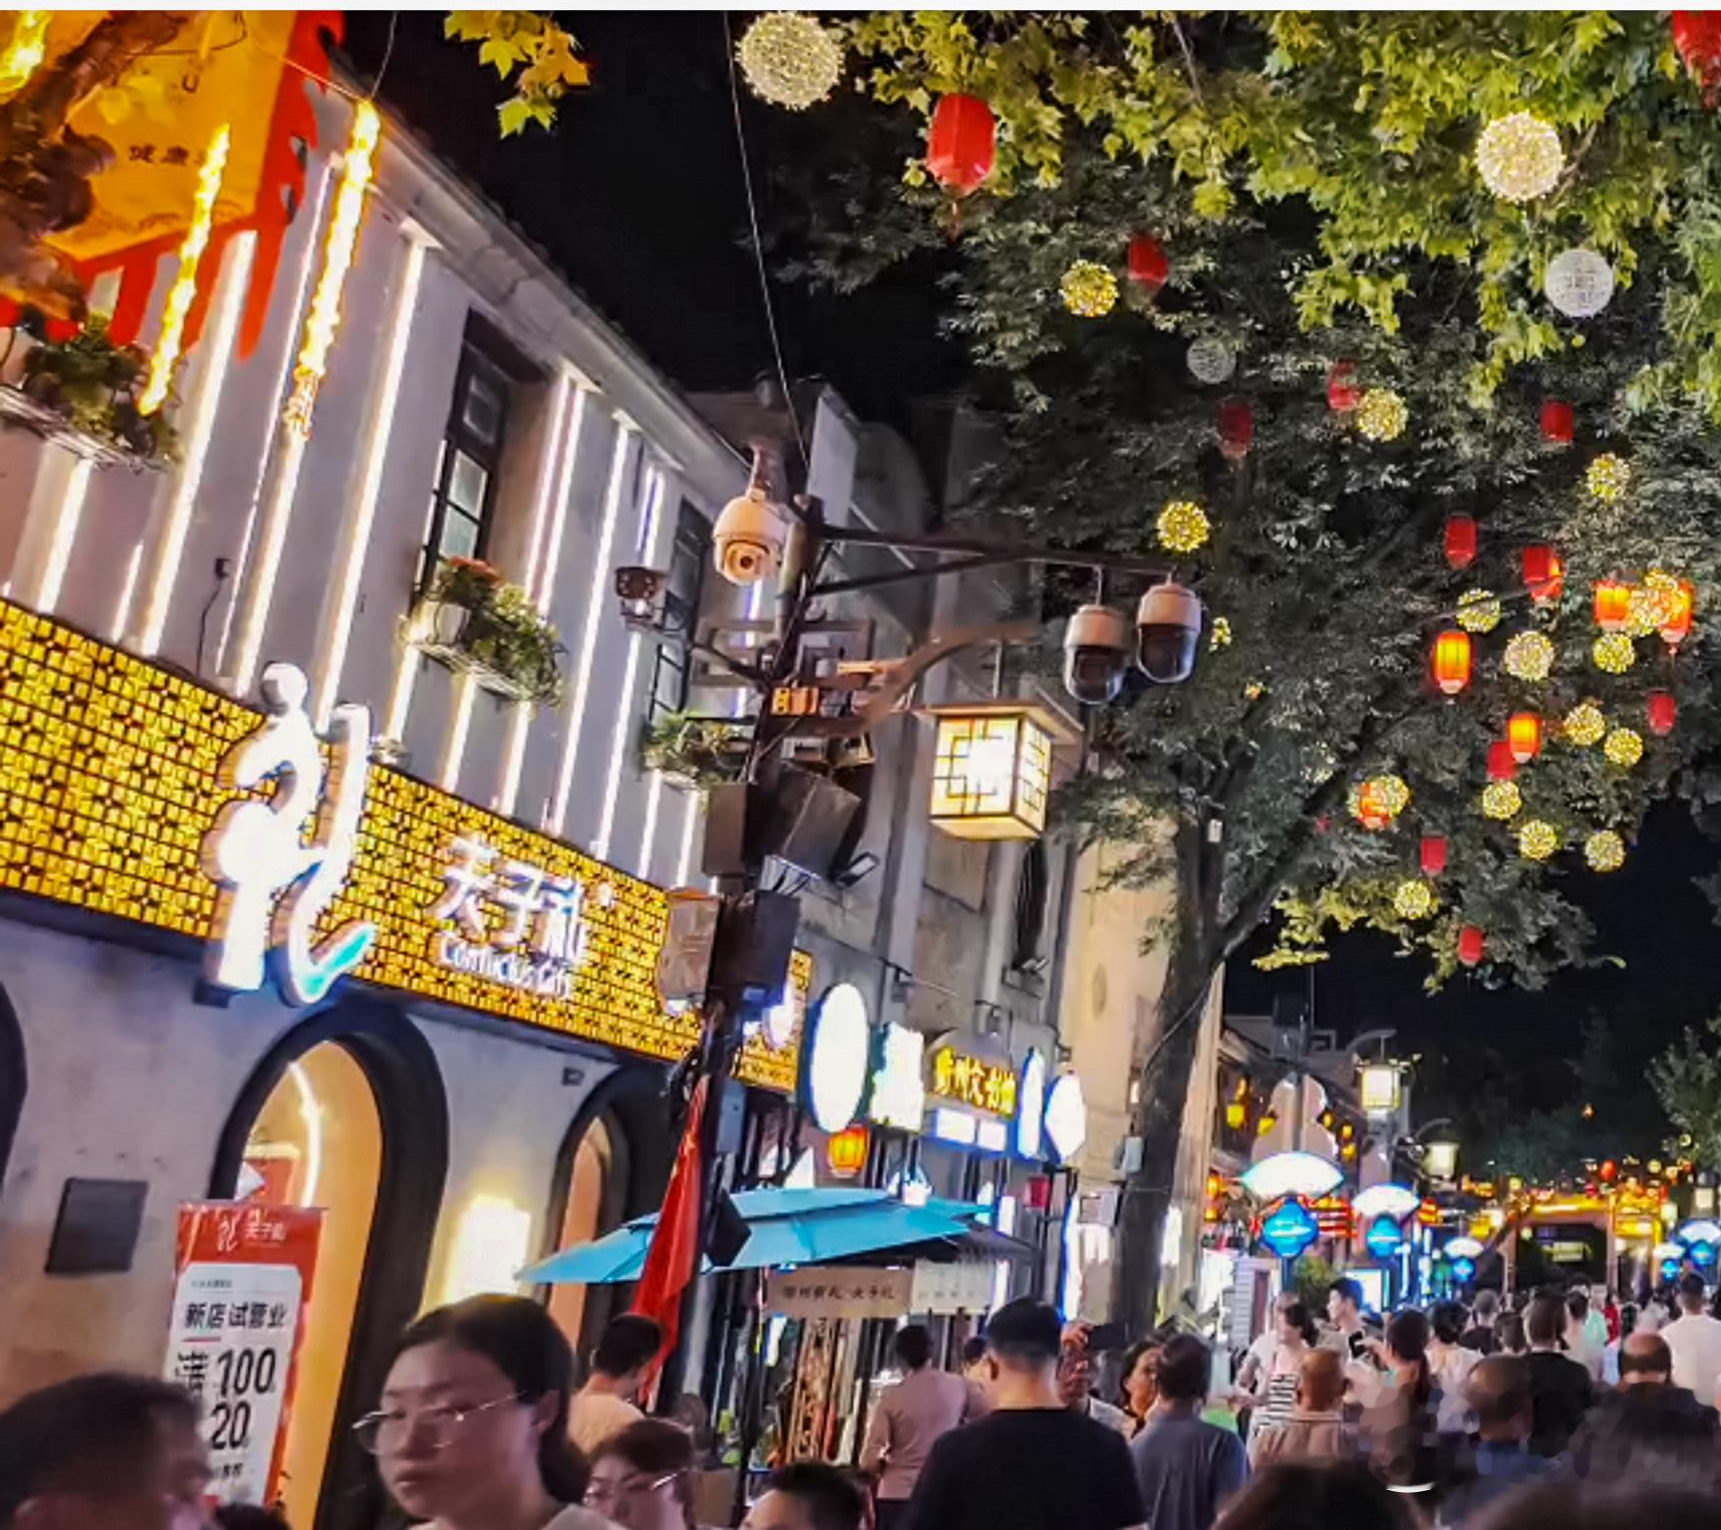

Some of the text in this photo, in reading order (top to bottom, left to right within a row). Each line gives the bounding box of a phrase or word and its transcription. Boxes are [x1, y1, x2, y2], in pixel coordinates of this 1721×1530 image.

[184, 1301, 287, 1330] 新店试营业
